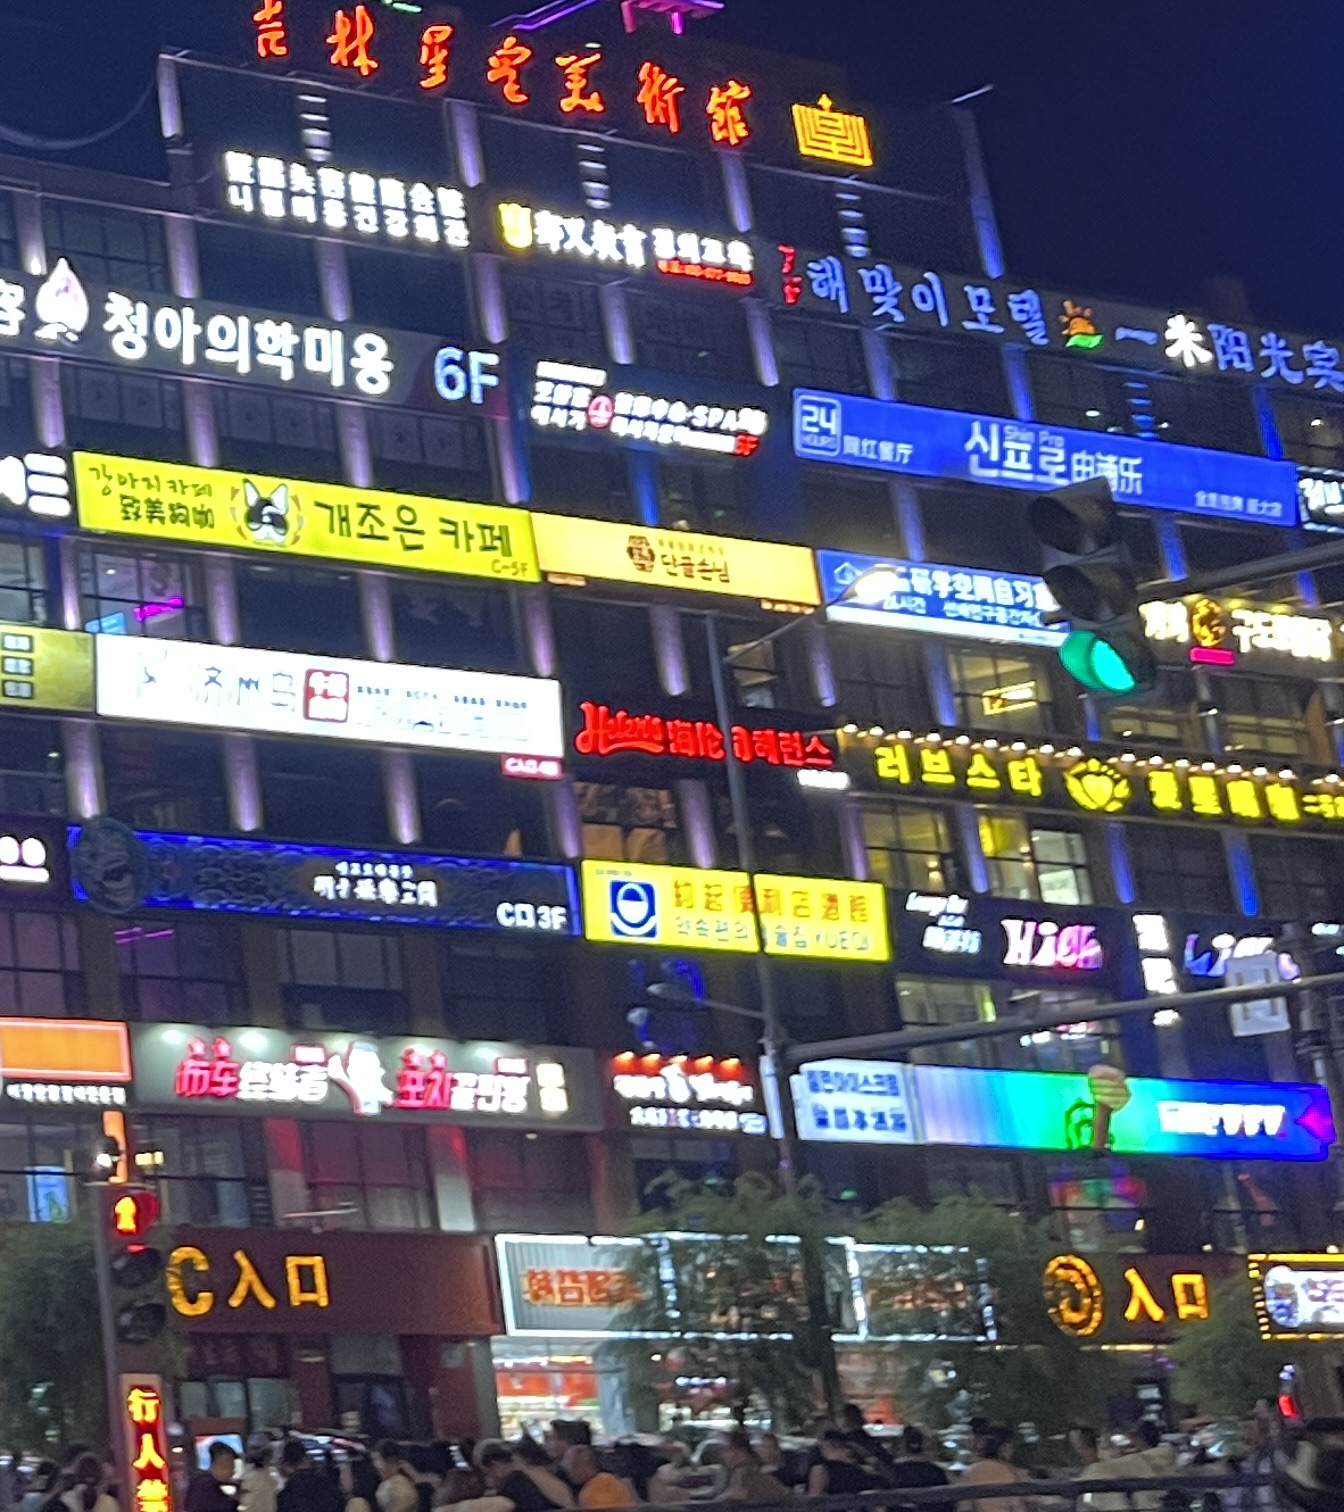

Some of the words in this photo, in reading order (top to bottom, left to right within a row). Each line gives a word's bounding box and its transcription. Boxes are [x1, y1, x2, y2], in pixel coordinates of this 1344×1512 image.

[103, 290, 396, 397] 청아의학미용
[432, 345, 501, 405] 6F
[801, 404, 837, 435] 24
[438, 517, 513, 558] 카페
[874, 742, 1044, 798] 러브스타
[165, 1245, 214, 1317] C
[227, 1248, 331, 1309] 入口
[1122, 1266, 1209, 1323] 入口
